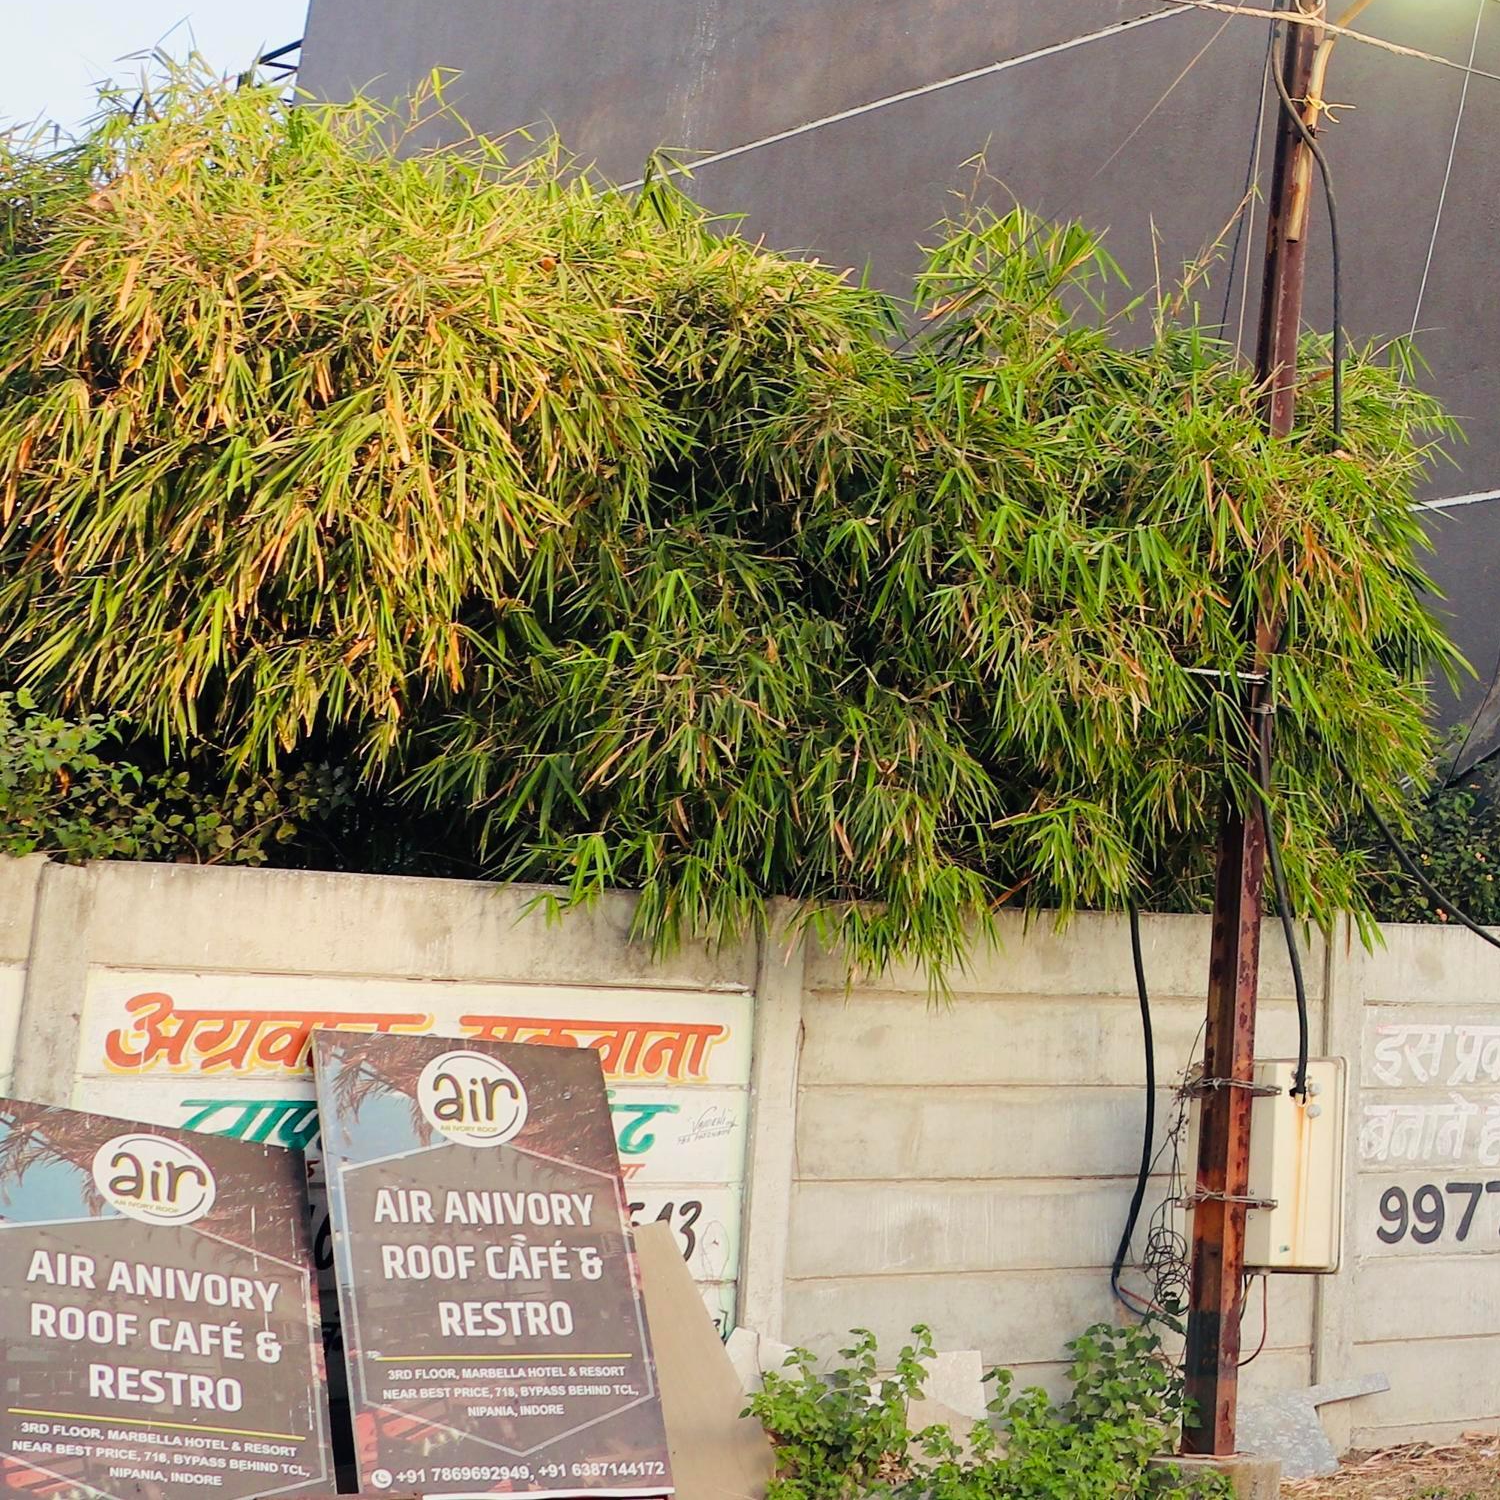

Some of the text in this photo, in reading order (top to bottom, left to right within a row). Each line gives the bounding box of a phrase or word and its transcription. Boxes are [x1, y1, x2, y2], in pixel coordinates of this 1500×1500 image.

[1372, 1024, 1451, 1086] इस
[432, 1072, 519, 1122] air
[108, 1151, 207, 1202] air
[374, 1189, 593, 1227] AIR ANIVORY
[381, 1239, 603, 1281] ROOF CAFÉ &
[26, 1250, 280, 1313] AIR ANIVORY
[30, 1302, 282, 1364] ROOF CAFÉ &
[438, 1301, 574, 1337] RESTRO
[89, 1363, 243, 1413] RESTRO
[387, 1366, 625, 1380] 3RD FLOOR, MARBELLA HOTEL & RESORT
[383, 1384, 639, 1400] NEAR BEST PRICE, 718, BYPASS BEHIND TCL,
[467, 1403, 565, 1417] NIPANIA, INDORE
[21, 1421, 297, 1457] 3RD FLOOR, MARBELLA HOTEL & RESORT
[12, 1440, 52, 1453] NEAR
[55, 1443, 93, 1457] BEST
[96, 1447, 141, 1462] PRICE,
[173, 1454, 227, 1468] BYPASS
[229, 1458, 279, 1473] BEHIND
[281, 1463, 311, 1477] TCL,
[109, 1466, 223, 1486] NIPANIA, INDORE
[396, 1460, 665, 1483] +91 7869692949, +91 6387144172
